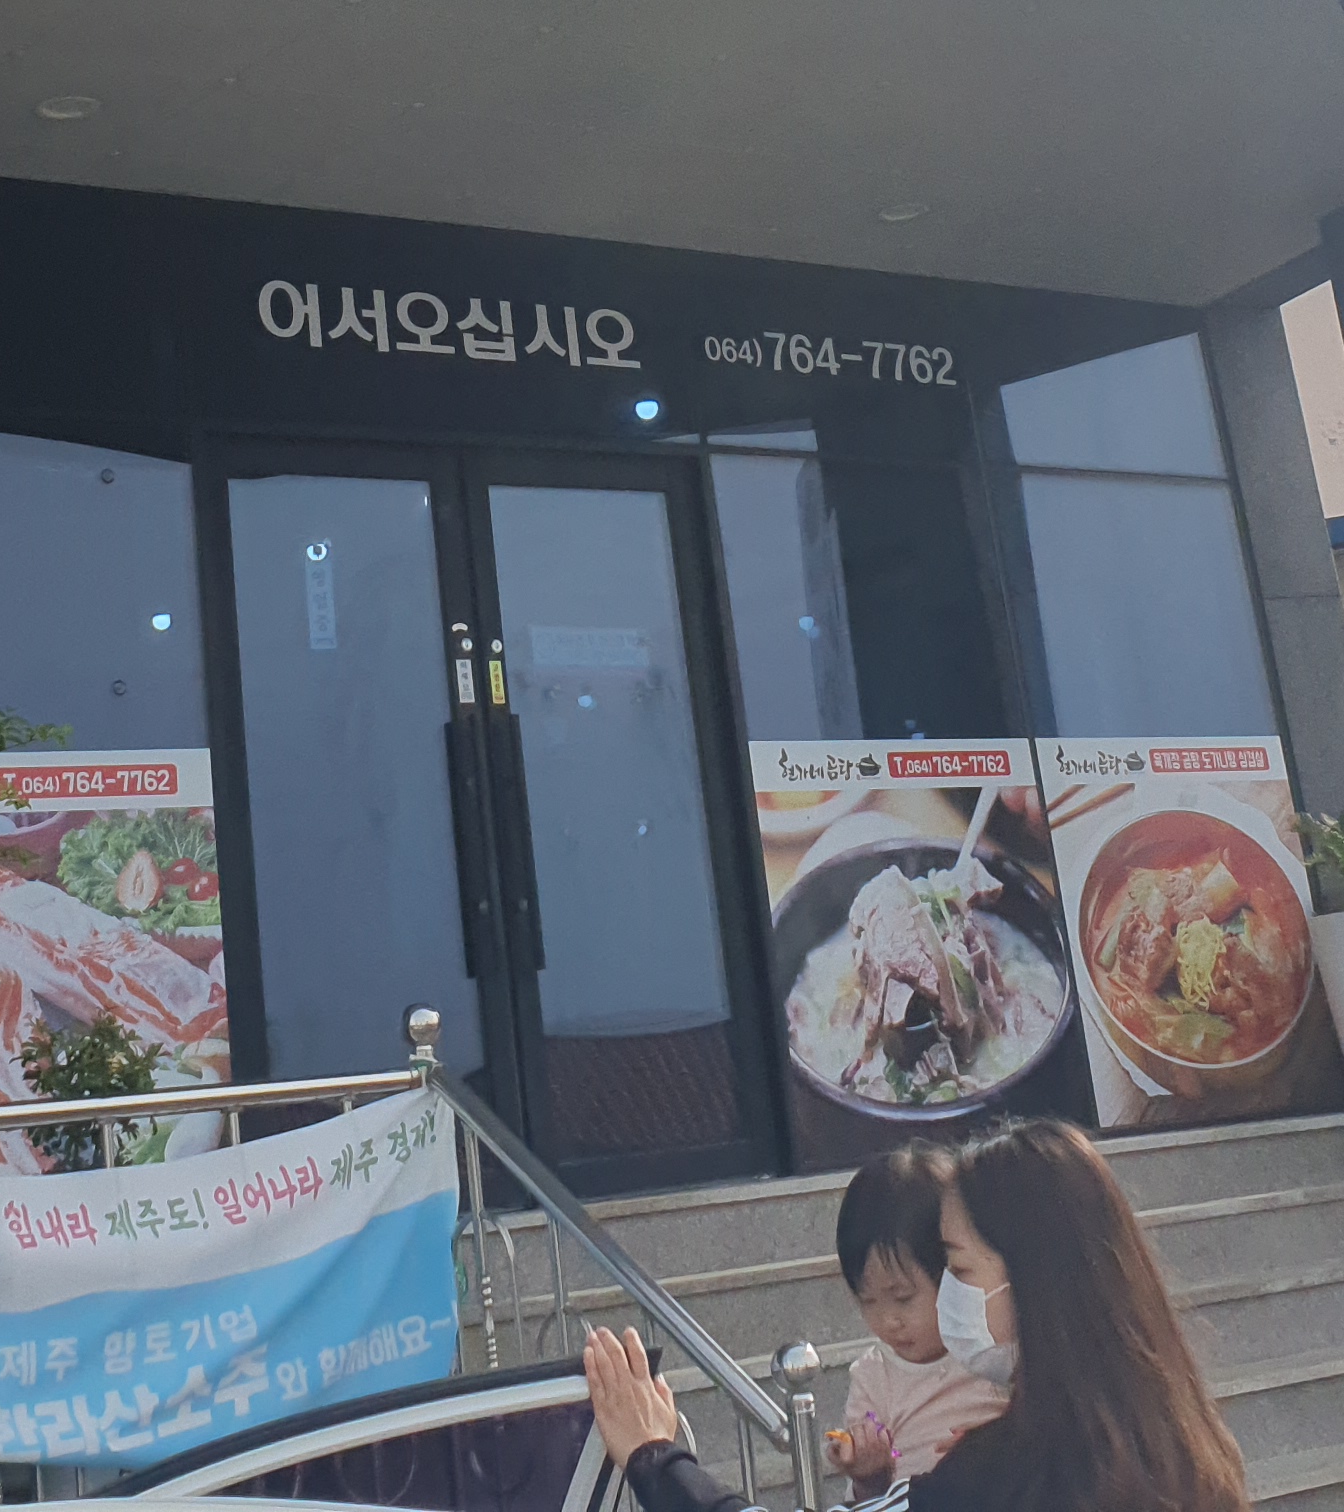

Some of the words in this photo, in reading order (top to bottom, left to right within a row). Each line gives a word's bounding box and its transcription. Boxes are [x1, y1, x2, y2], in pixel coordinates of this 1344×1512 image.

[258, 280, 641, 369] 어서오십시오
[4, 1199, 97, 1248] 힘내라
[105, 1189, 210, 1240] 제주도!
[214, 1156, 324, 1224] 일어나라
[330, 1138, 378, 1188] 제주
